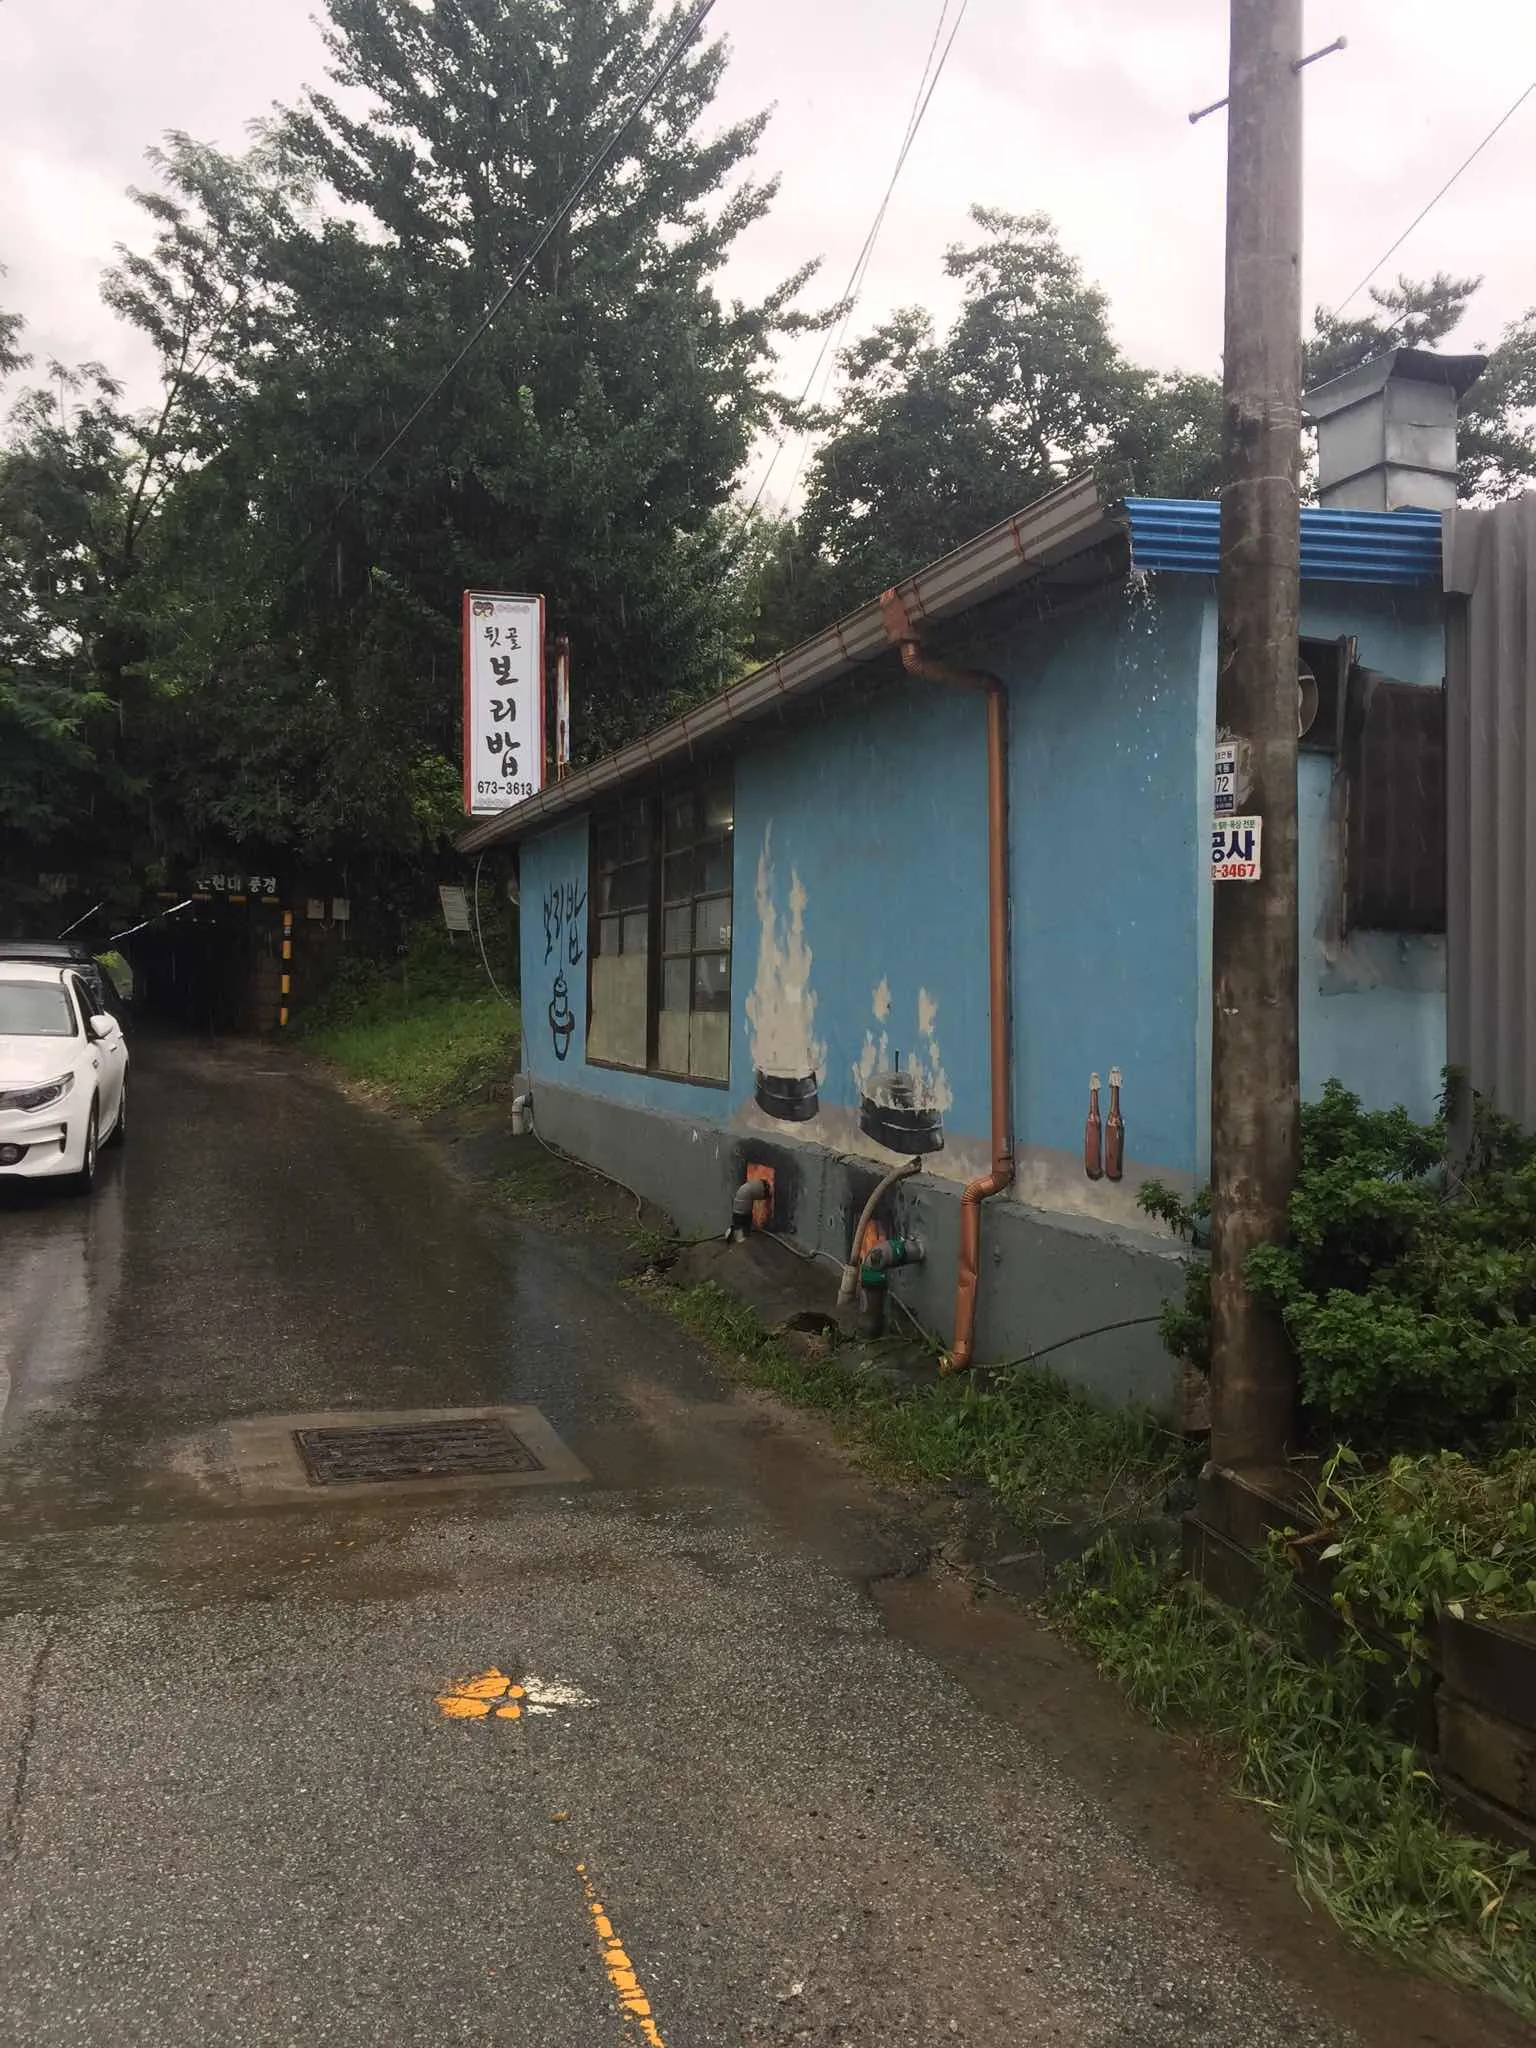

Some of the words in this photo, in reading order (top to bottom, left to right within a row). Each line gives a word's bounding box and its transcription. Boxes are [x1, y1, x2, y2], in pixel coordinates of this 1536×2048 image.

[484, 626, 522, 650] 뒷골
[485, 655, 521, 778] 보리밥
[477, 781, 533, 796] 673-3613
[1211, 830, 1256, 863] 공사
[247, 875, 278, 894] 풍경
